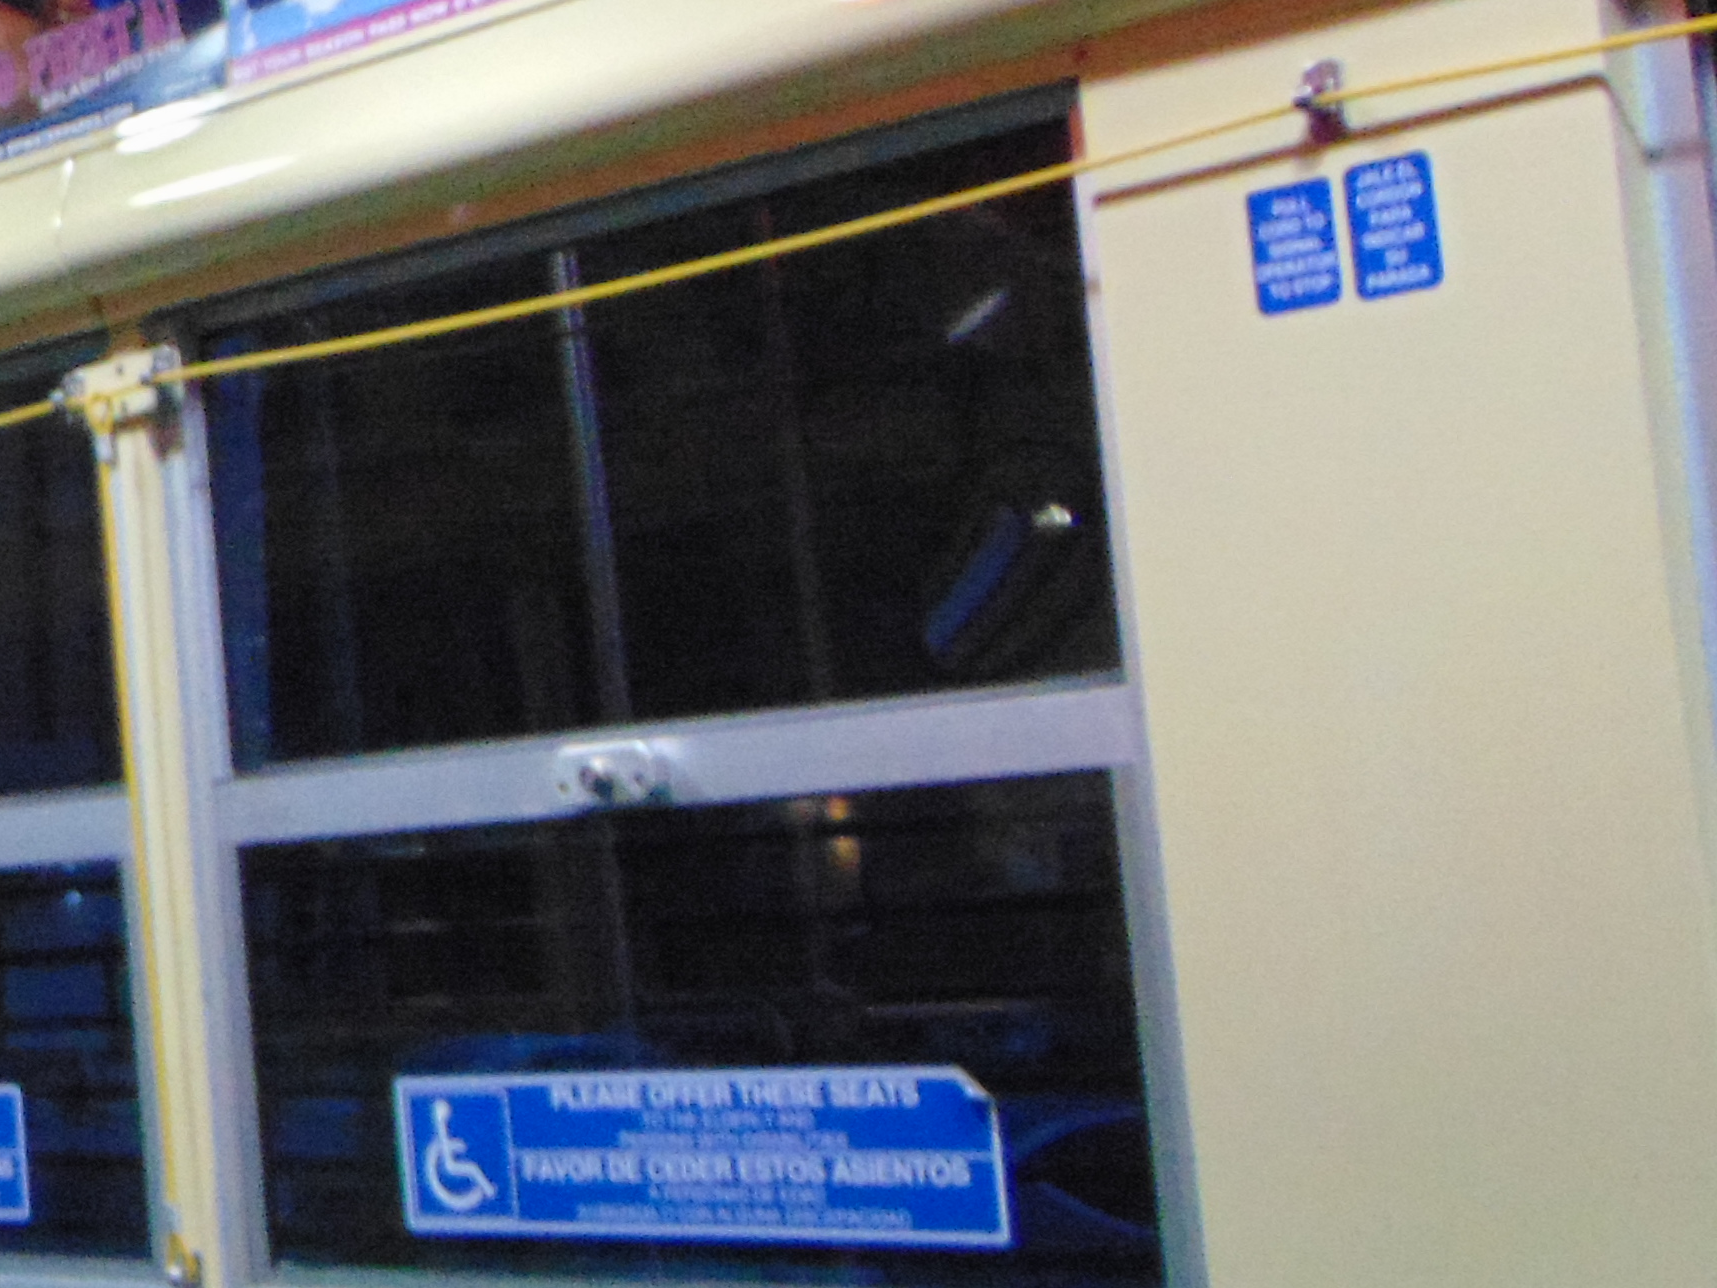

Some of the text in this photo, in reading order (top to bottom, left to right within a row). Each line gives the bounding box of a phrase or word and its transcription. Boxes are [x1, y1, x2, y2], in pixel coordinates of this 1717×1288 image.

[548, 1080, 645, 1110] PLEASE
[827, 1079, 921, 1108] SEATS
[521, 1152, 603, 1183] FAVOR
[831, 1154, 972, 1188] ASIENTOS
